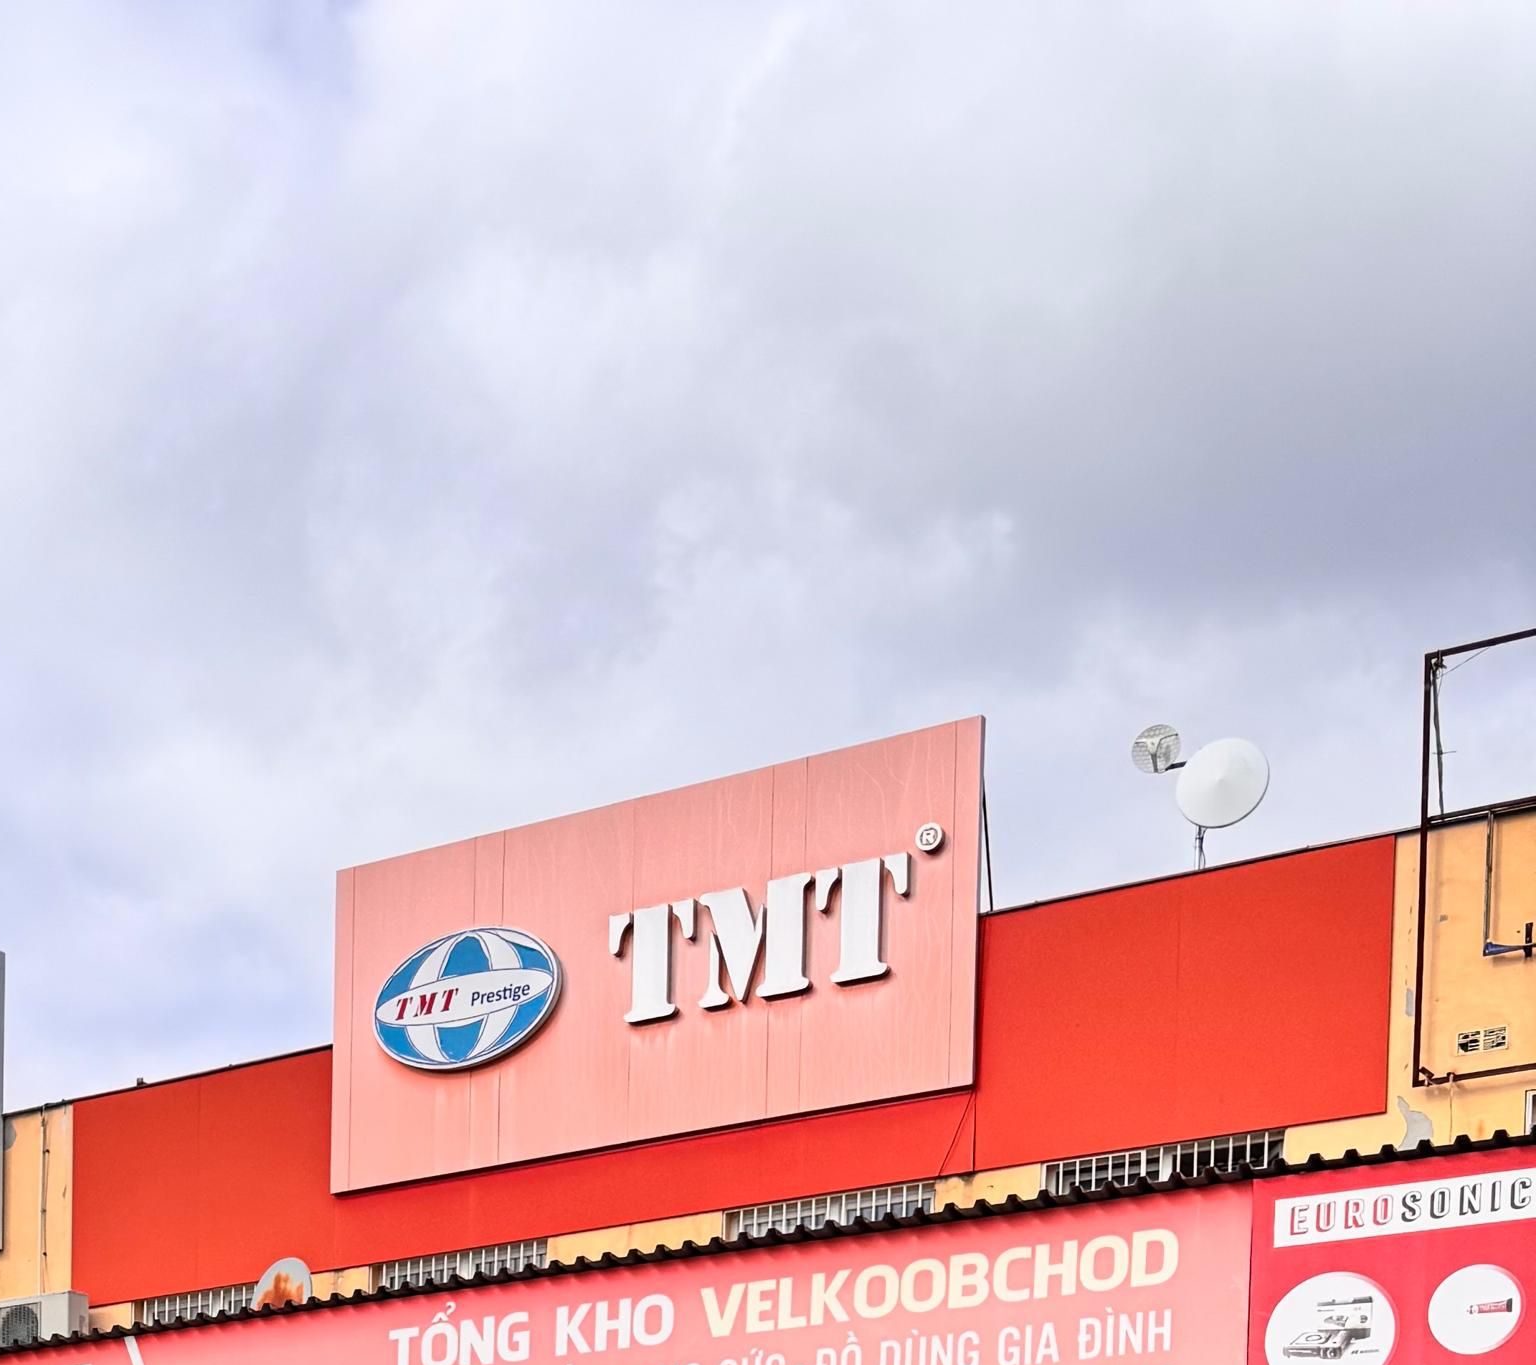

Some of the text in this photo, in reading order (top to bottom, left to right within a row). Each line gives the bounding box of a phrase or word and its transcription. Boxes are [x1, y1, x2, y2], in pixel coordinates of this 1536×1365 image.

[608, 850, 912, 1027] TMT
[394, 980, 531, 1022] TMT Prestige
[1290, 1176, 1534, 1236] EUROSONIC
[554, 1293, 675, 1357] KHO
[700, 1228, 1179, 1338] VELKOOBCHOD
[1078, 1306, 1172, 1360] ĐÌNH
